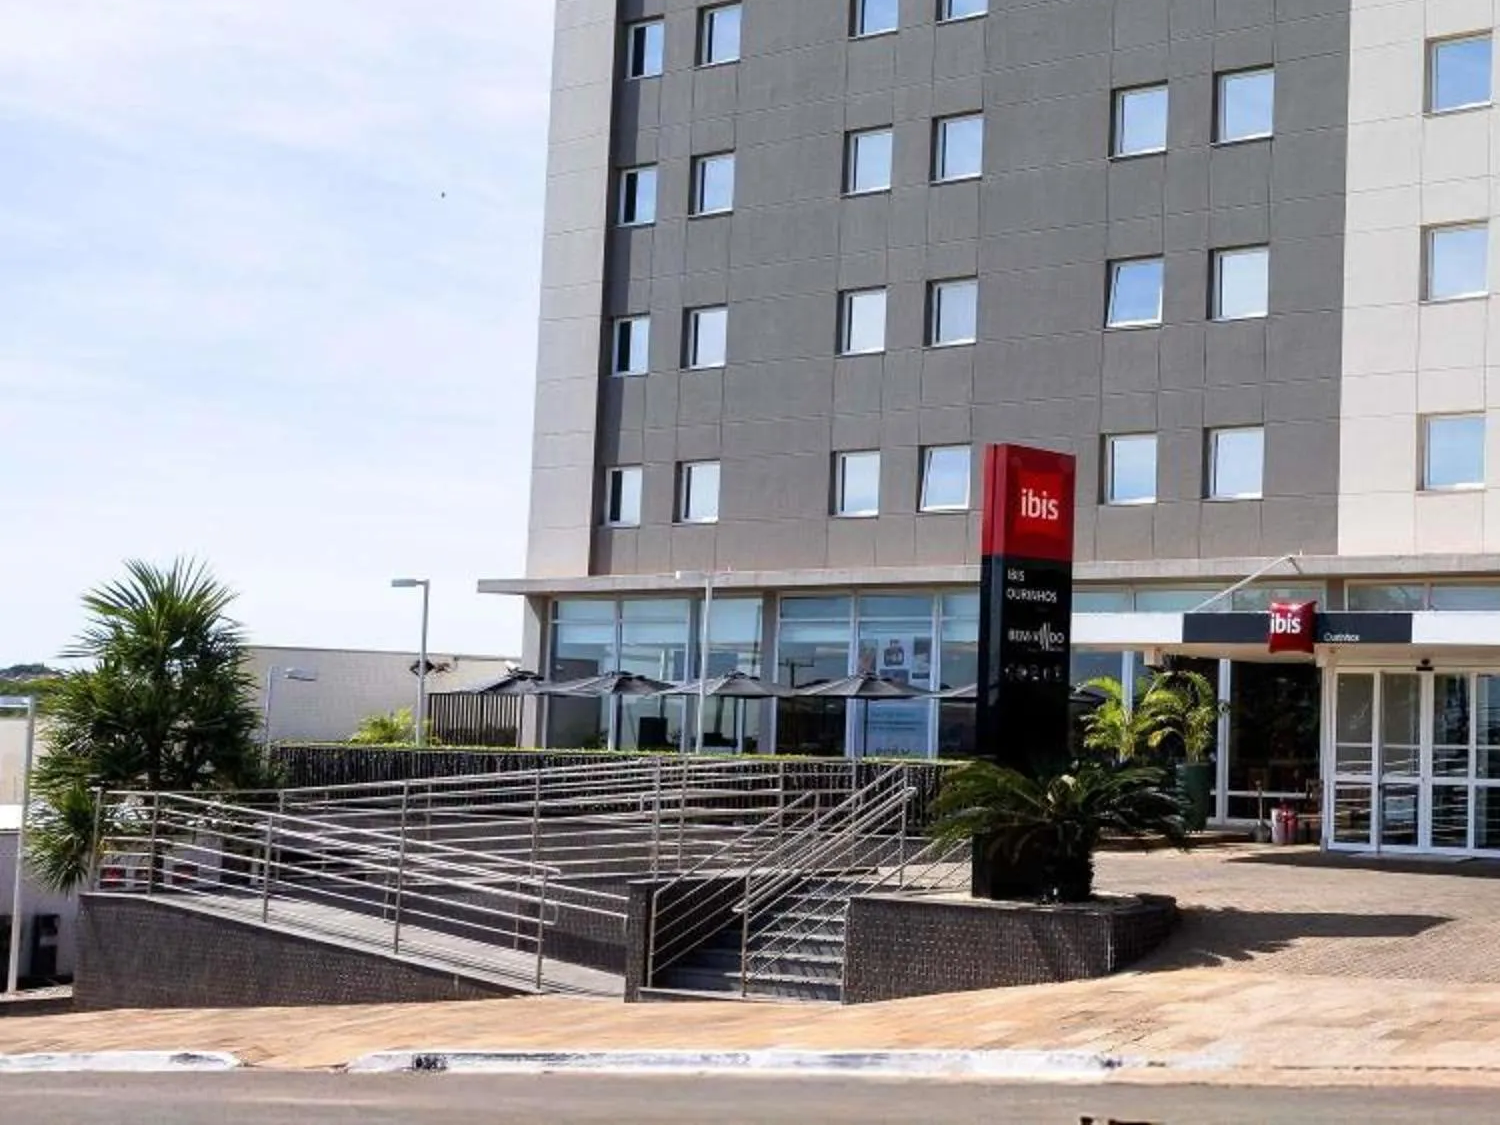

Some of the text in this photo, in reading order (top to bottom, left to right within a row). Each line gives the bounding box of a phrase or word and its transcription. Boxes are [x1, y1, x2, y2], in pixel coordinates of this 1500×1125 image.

[1021, 488, 1059, 520] ibis
[1006, 587, 1057, 603] OURINHOS
[1270, 613, 1301, 634] ibis
